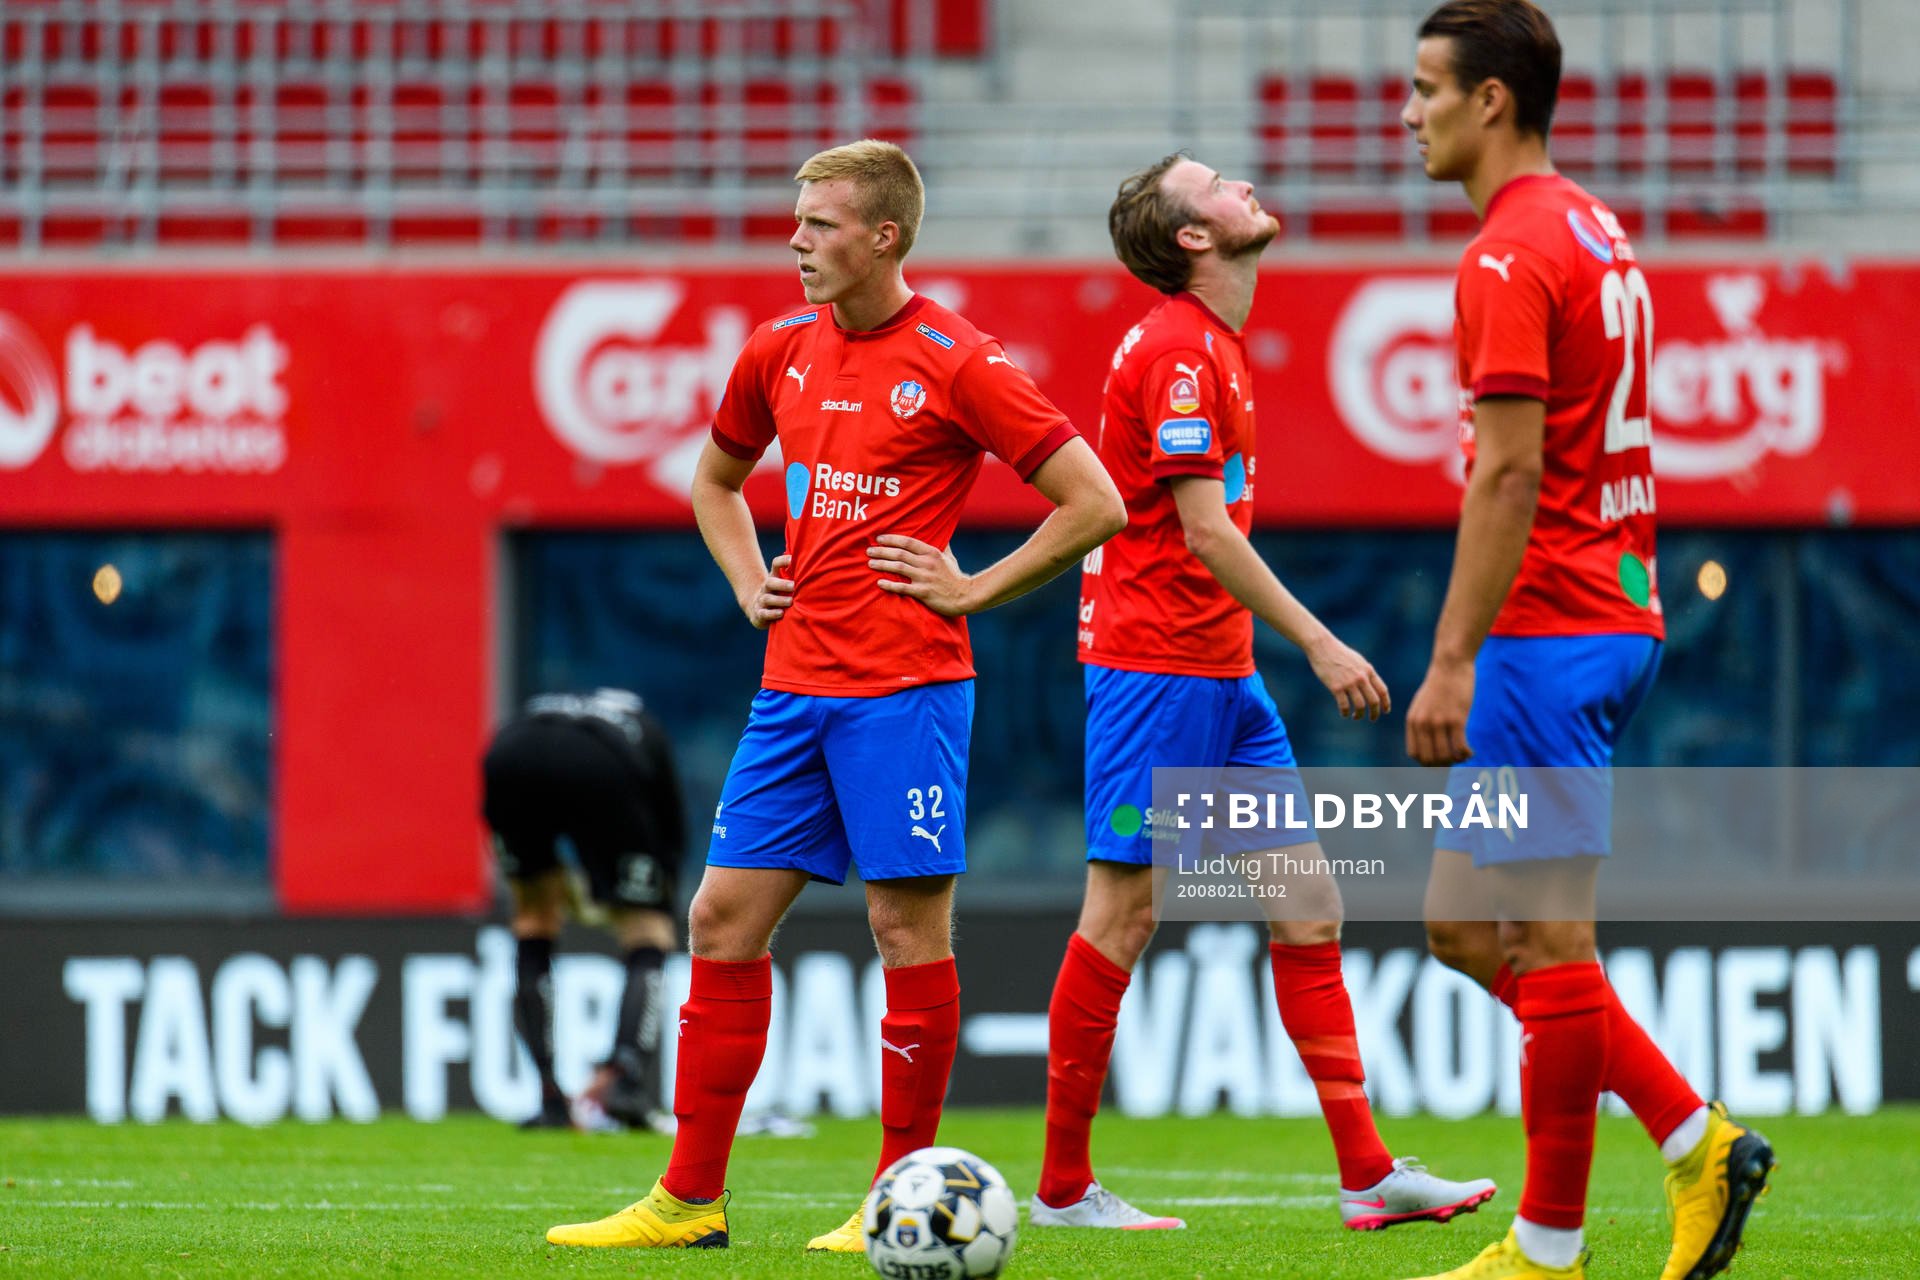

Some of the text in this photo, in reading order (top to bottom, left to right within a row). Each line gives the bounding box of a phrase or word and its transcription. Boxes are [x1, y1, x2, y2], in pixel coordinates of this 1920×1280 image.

[64, 320, 290, 416] beat
[820, 399, 863, 413] stadium
[1162, 427, 1209, 440] UNIBET
[814, 462, 901, 497] Resurs
[811, 491, 869, 521] Bank
[906, 785, 946, 821] 32
[63, 952, 380, 1125] TACK
